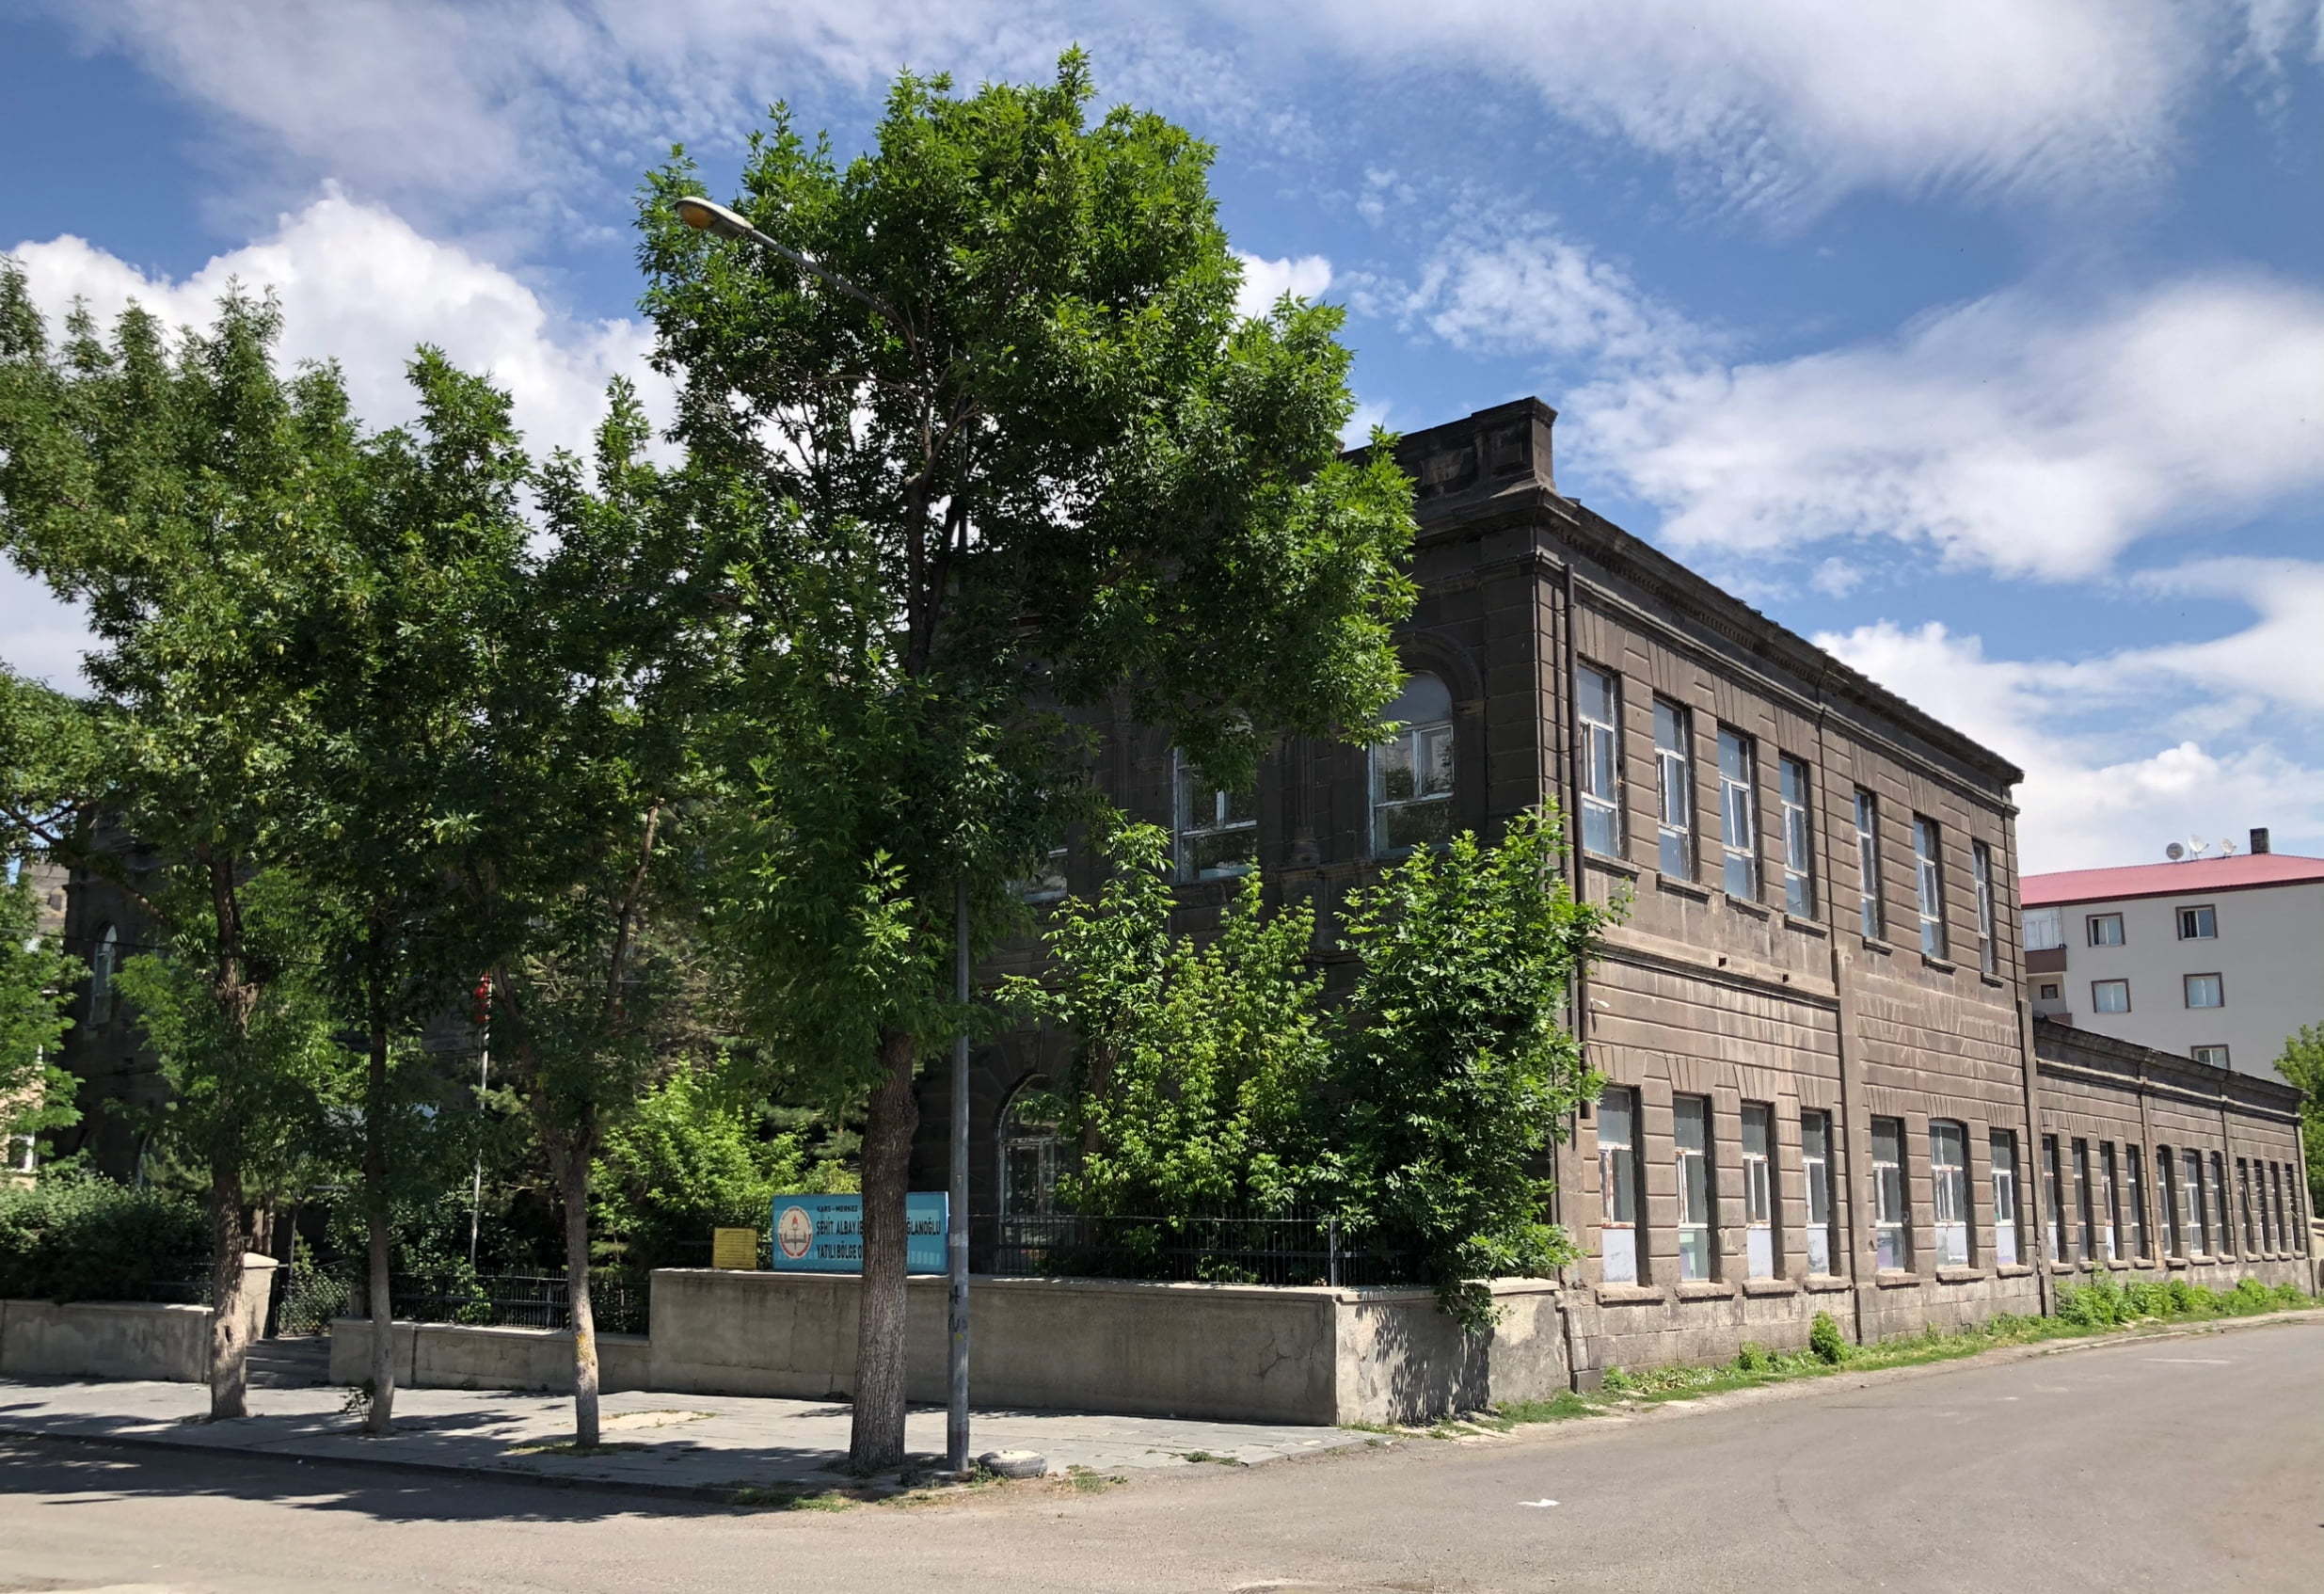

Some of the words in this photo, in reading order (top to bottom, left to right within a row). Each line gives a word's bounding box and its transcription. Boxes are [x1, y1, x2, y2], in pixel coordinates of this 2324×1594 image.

[836, 1219, 856, 1235] ALBAY
[906, 1217, 941, 1235] ĞLANOĞLU
[836, 1240, 856, 1259] BÖLGE
